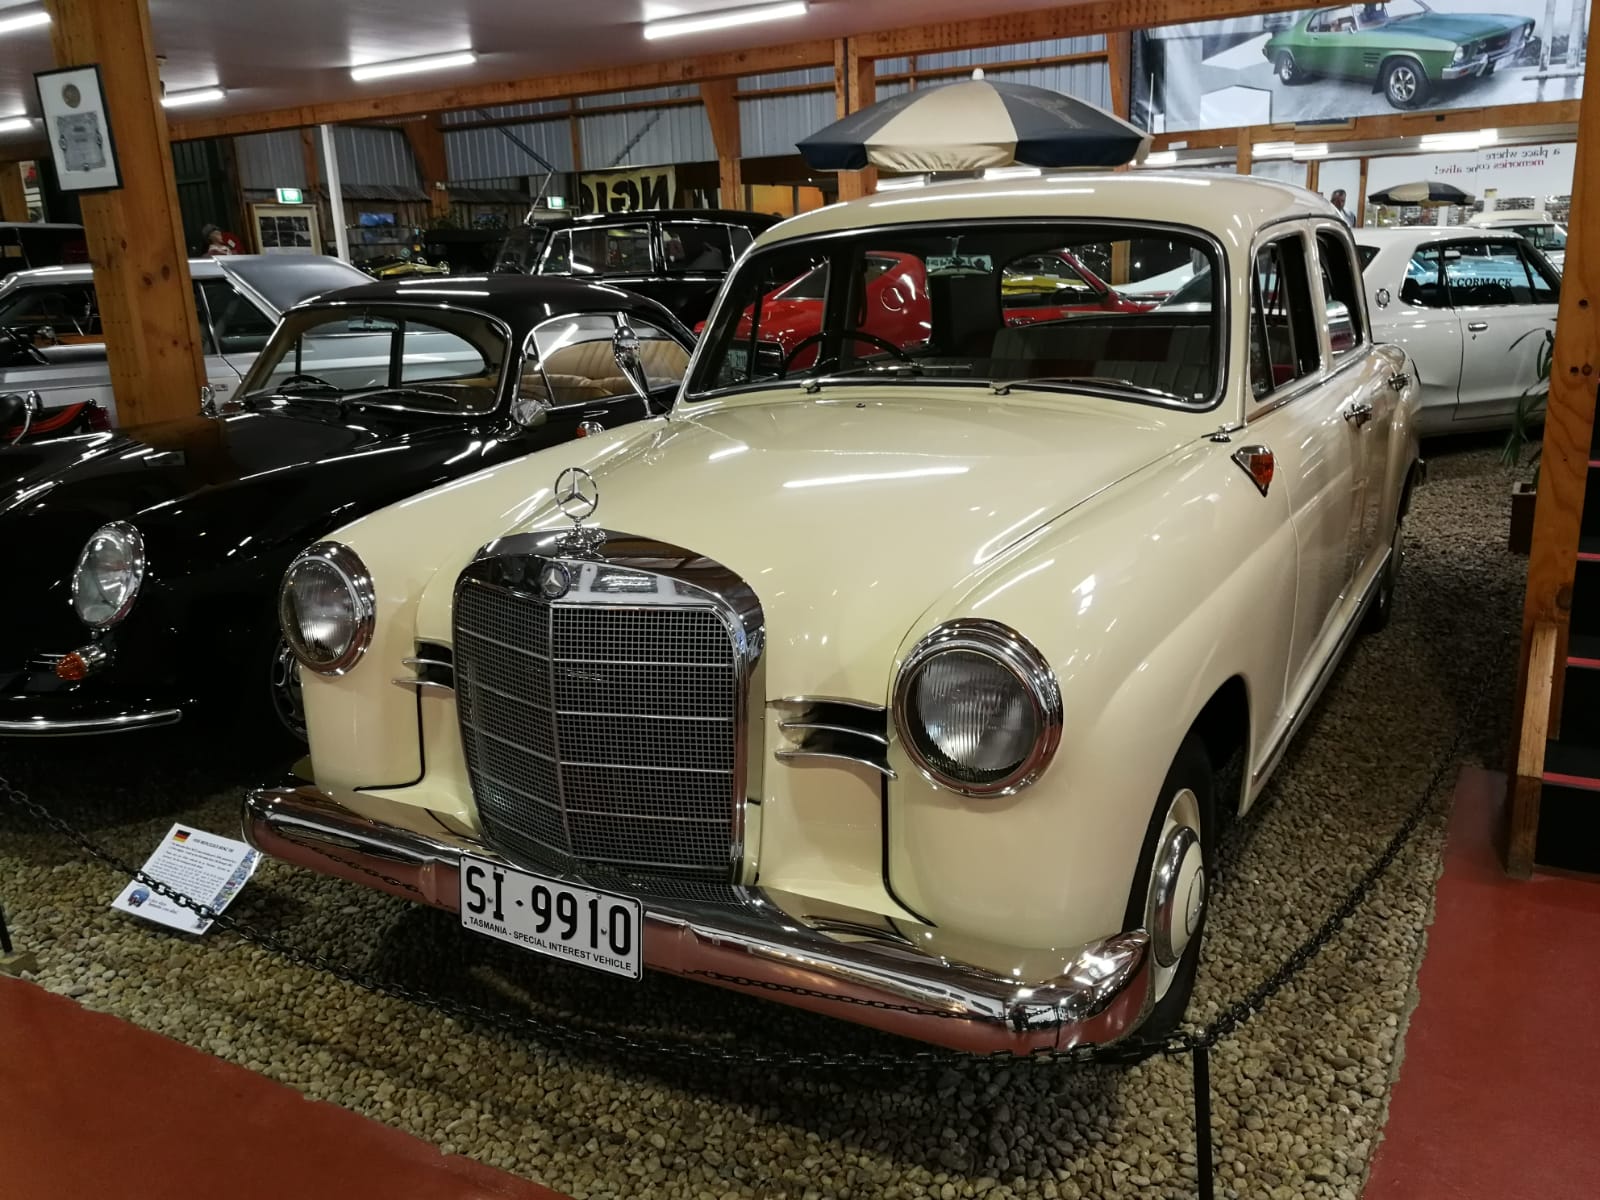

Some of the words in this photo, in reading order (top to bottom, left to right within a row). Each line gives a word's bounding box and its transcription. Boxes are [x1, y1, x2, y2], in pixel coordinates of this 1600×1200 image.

[469, 916, 507, 936] TASMANIA
[513, 931, 547, 949] SPECIAL
[549, 942, 591, 960] INTEREST
[593, 954, 631, 971] VEHICLE
